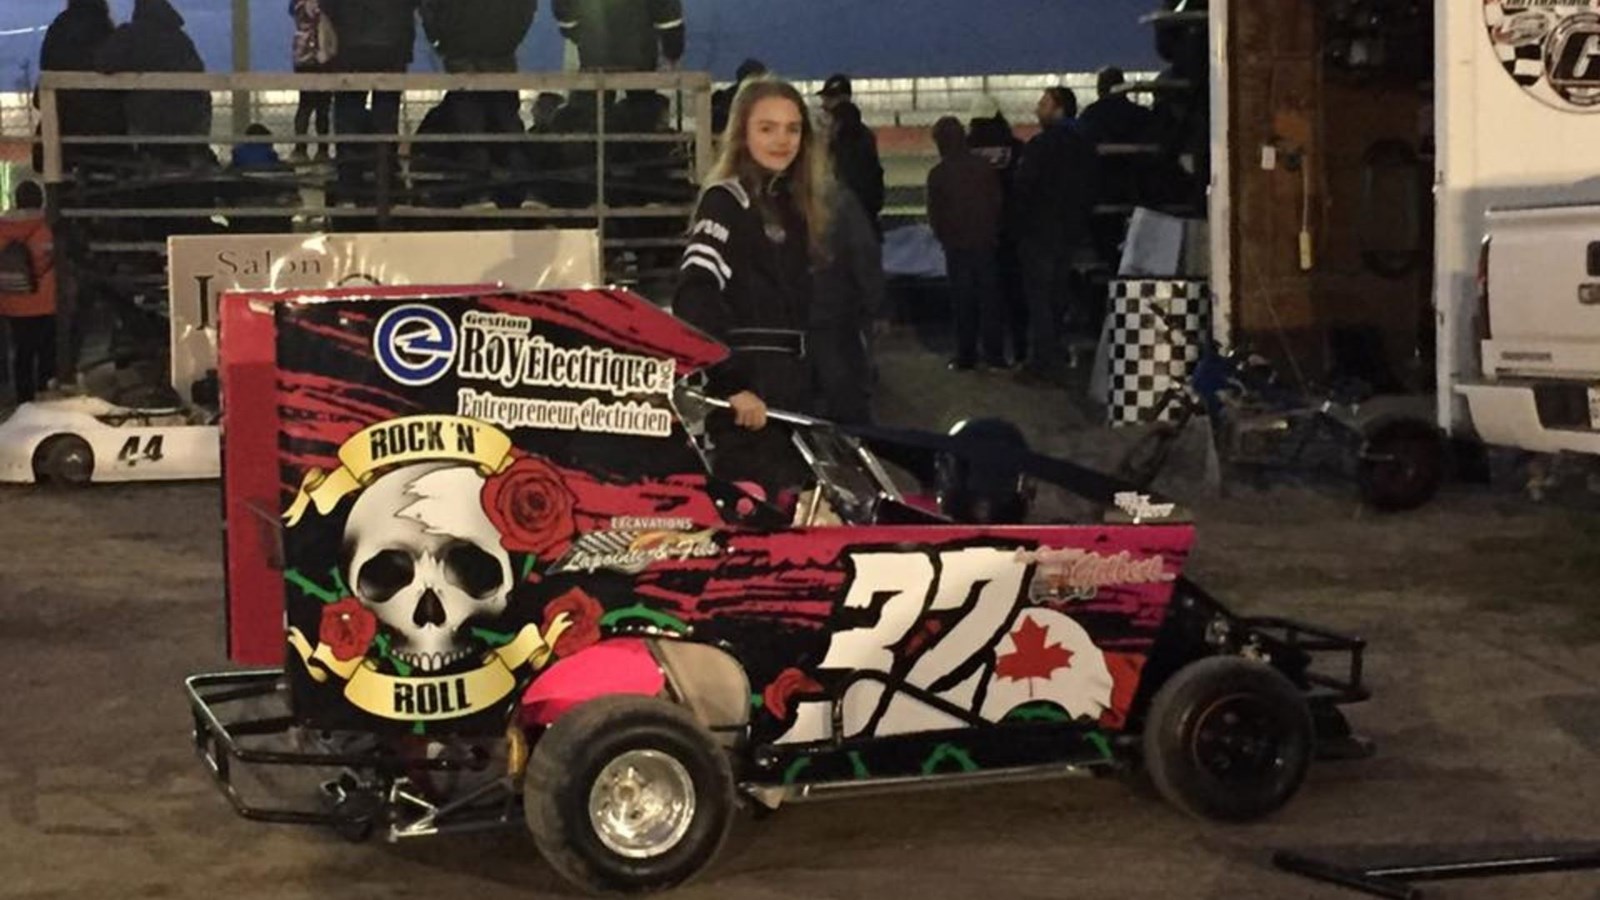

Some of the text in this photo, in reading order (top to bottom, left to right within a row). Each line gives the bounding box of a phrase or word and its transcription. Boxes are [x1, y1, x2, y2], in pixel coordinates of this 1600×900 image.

[217, 250, 322, 276] Salon
[464, 314, 529, 330] Gestion
[460, 391, 669, 433] Entrepreneur électricien
[118, 434, 164, 467] 44
[370, 421, 445, 461] ROCK
[610, 516, 693, 530] EXCAVATIONS
[393, 678, 473, 715] ROLL
